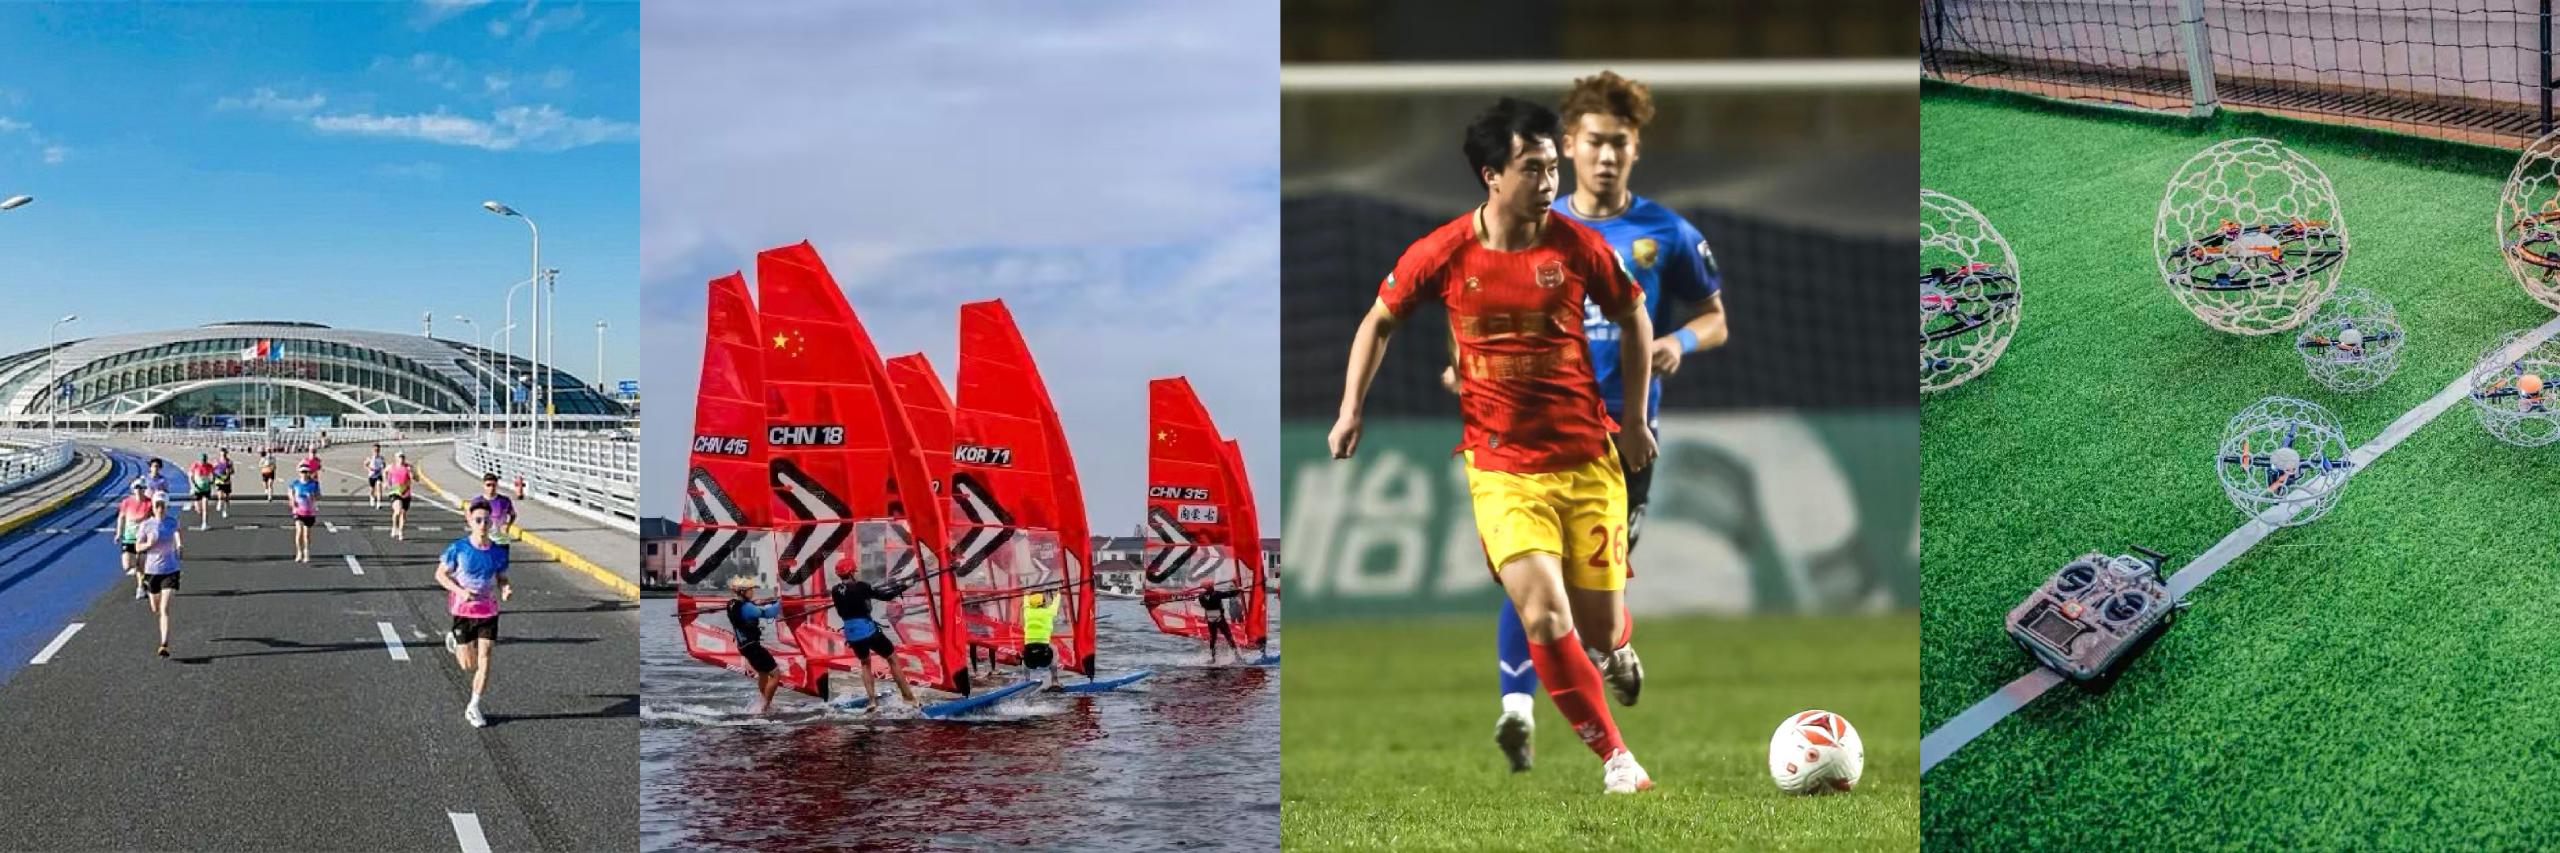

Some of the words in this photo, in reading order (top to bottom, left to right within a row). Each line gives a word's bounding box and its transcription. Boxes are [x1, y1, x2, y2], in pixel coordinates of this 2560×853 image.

[769, 426, 818, 445] CHN
[821, 426, 844, 445] 18
[693, 436, 724, 454] CHN
[723, 438, 749, 455] 415
[954, 445, 987, 462] KOR
[990, 448, 1010, 464] 71
[1149, 486, 1181, 498] CHN
[1184, 488, 1208, 500] 315
[1588, 524, 1624, 568] 26
